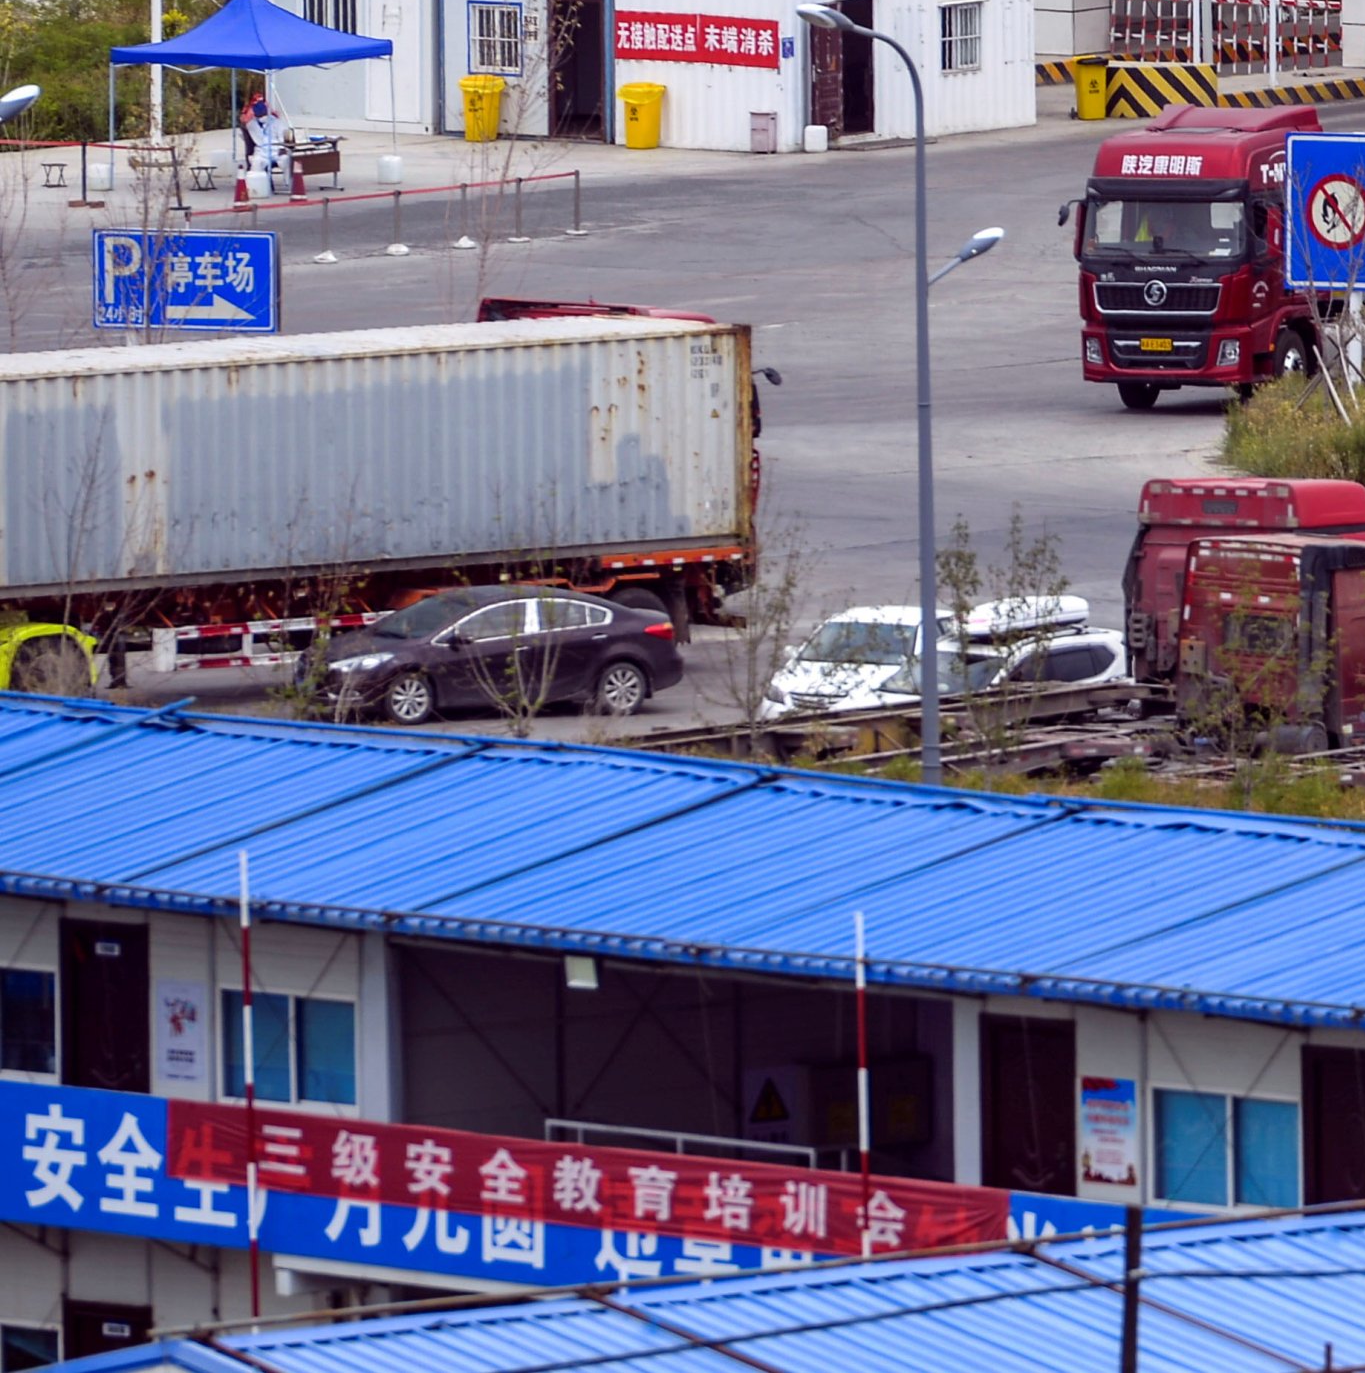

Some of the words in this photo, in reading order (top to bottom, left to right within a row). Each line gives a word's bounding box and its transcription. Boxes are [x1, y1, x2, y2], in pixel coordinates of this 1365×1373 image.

[617, 21, 697, 52] 无接触配送点
[704, 24, 775, 57] 末端消杀
[1121, 154, 1204, 176] 陕汽康明斯
[103, 235, 142, 304] P
[164, 250, 255, 294] 停车场
[257, 1123, 907, 1248] 三级安全教育培训会
